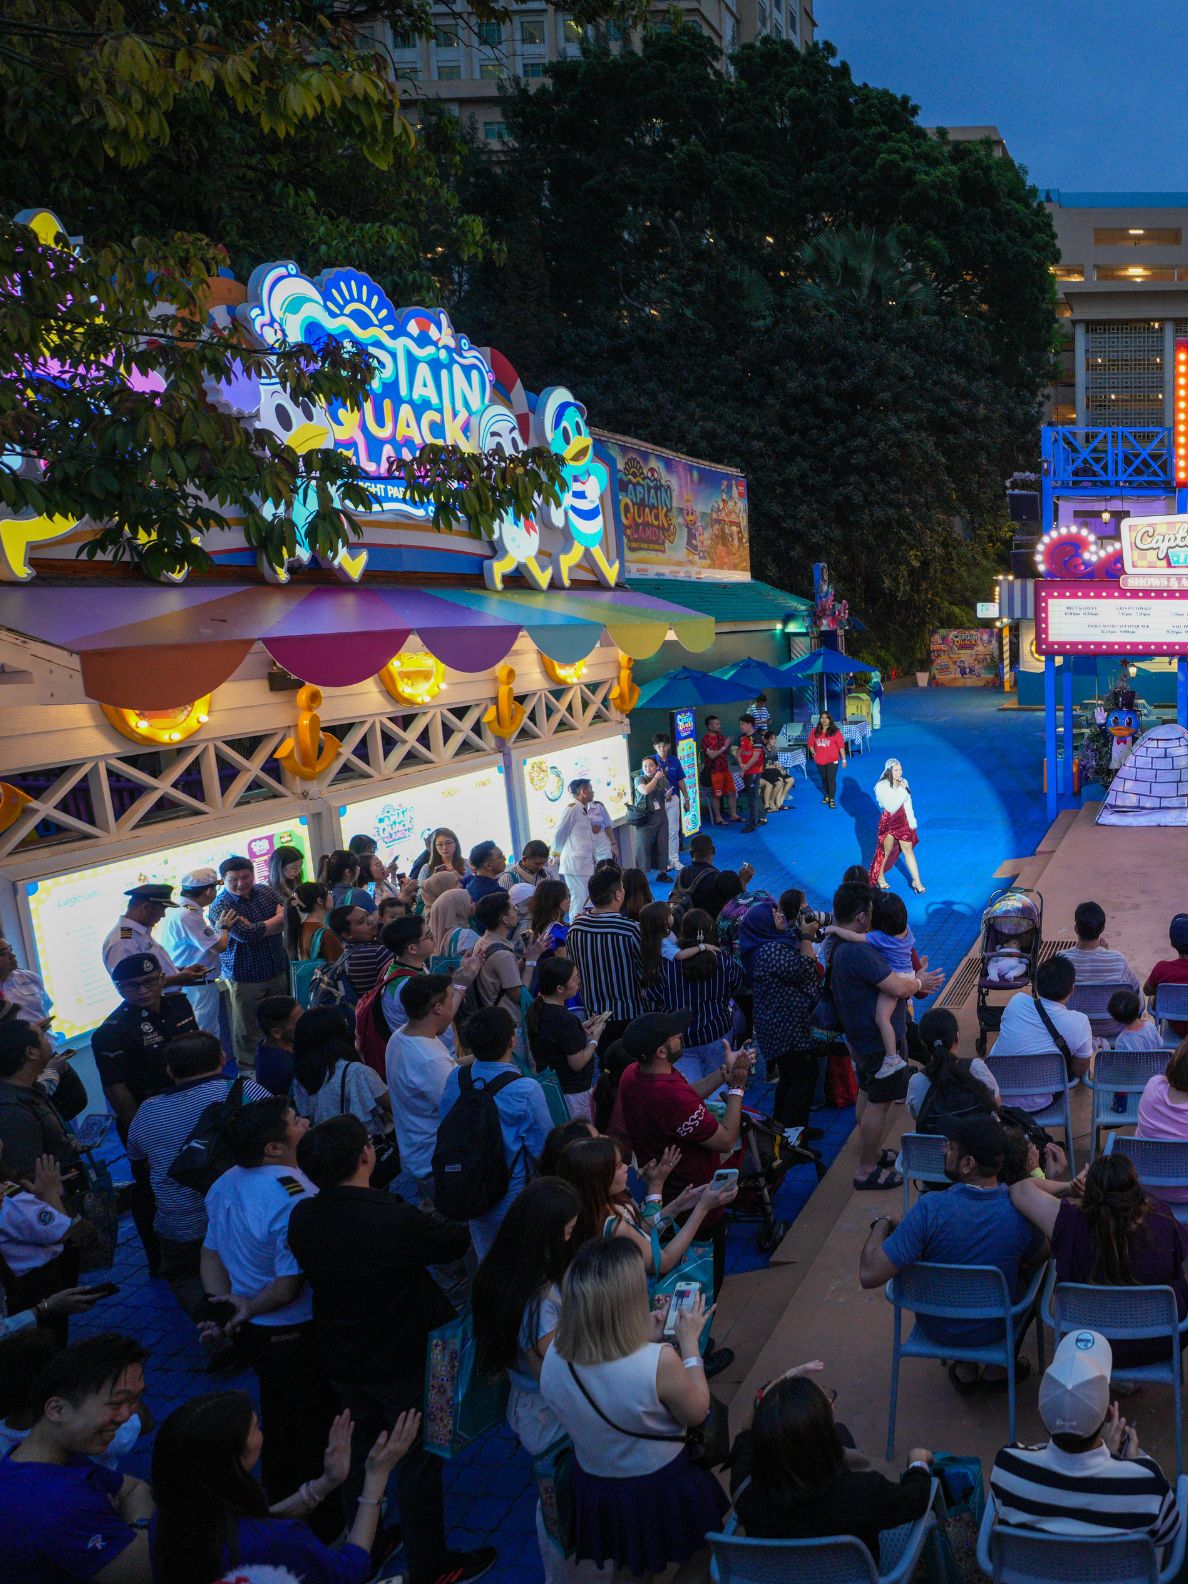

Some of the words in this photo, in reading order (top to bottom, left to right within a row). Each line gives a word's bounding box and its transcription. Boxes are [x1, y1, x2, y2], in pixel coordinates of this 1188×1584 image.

[620, 496, 670, 529] QUACK
[1128, 576, 1168, 588] SHOWS
[1169, 577, 1179, 589] &
